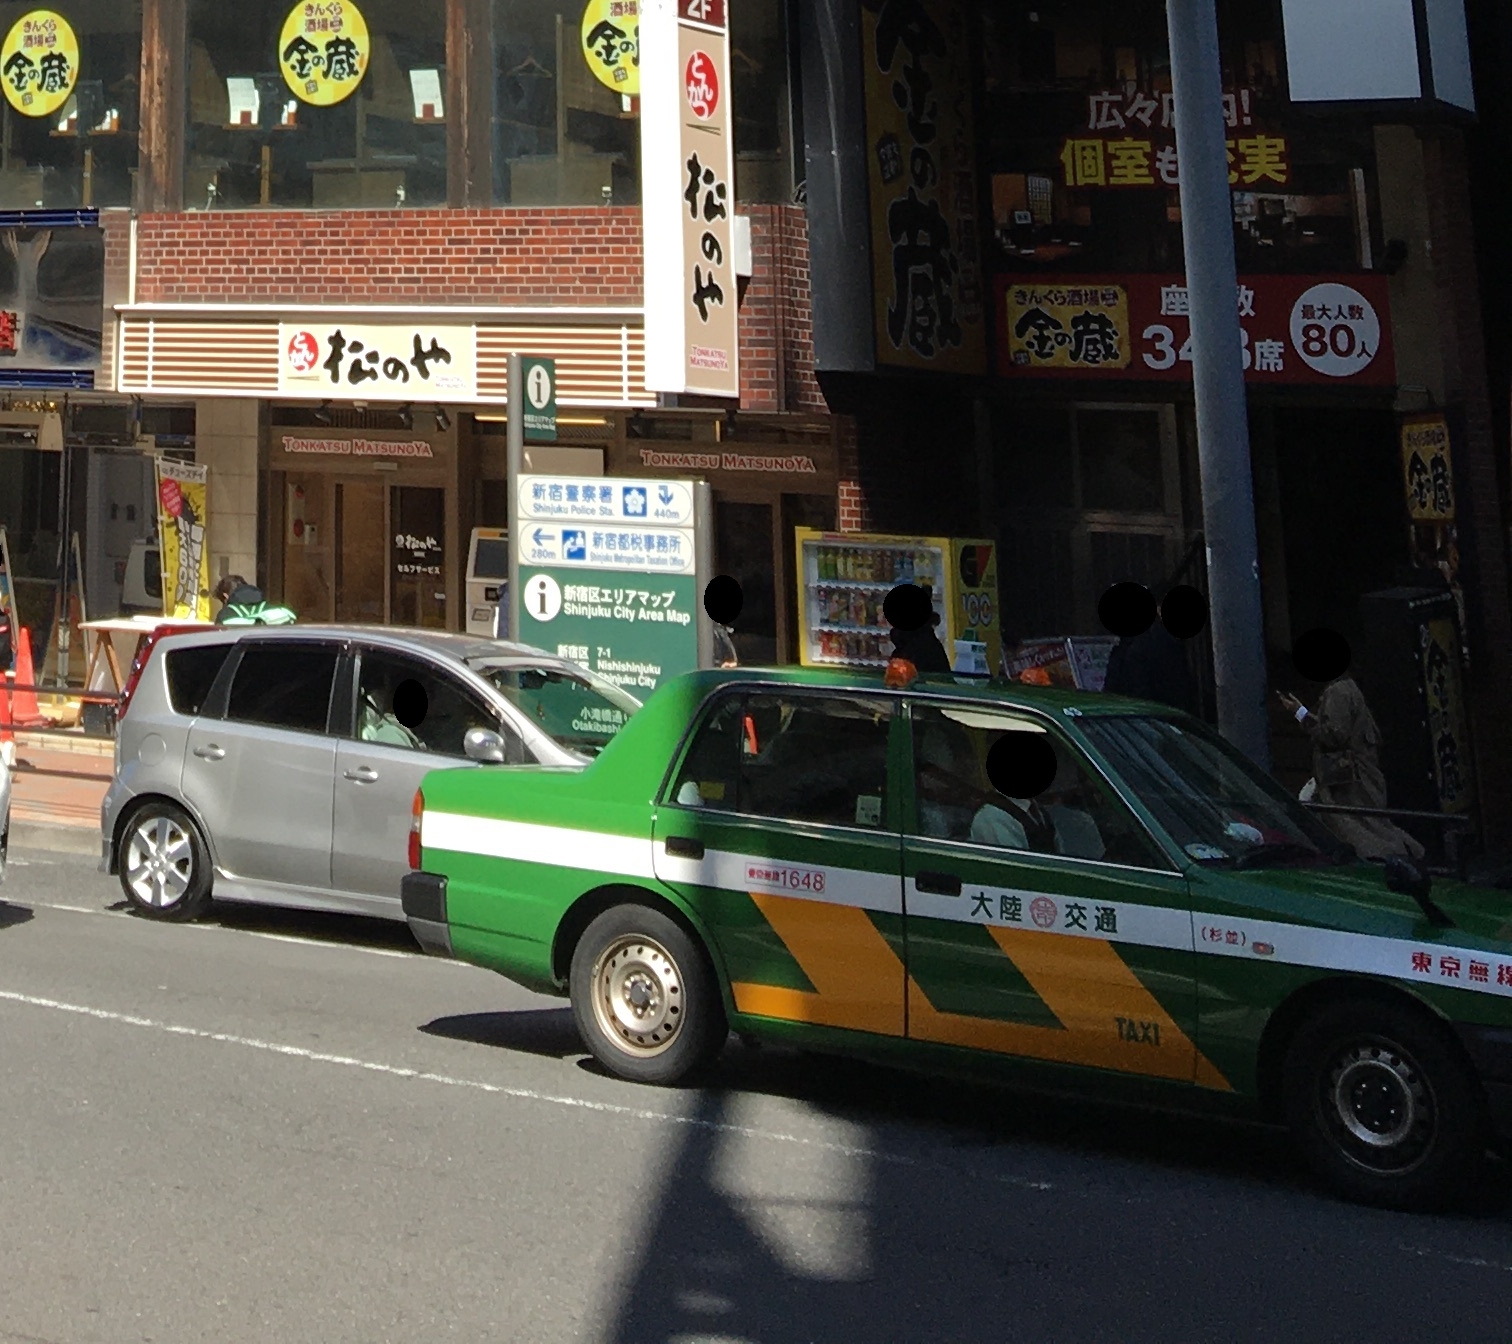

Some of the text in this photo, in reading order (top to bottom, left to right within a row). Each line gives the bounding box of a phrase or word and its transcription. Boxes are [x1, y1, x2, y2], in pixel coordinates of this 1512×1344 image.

[305, 2, 343, 16] きんくら
[23, 18, 57, 32] きんくら
[586, 19, 639, 68] 金の
[283, 33, 360, 82] 金の蔵
[4, 49, 71, 92] 金の蔵
[684, 151, 727, 324] 松のや
[1014, 288, 1100, 306] きんくら酒場
[1301, 303, 1365, 321] 最大人数
[1015, 307, 1121, 364] 金の蔵
[1301, 323, 1372, 360] 80人
[323, 329, 452, 385] 松のや
[690, 345, 727, 359] TONKATSU
[282, 436, 433, 458] TONKATSU MATSUNOYA
[640, 449, 816, 473] TONKATSU MATSUNOYA
[532, 483, 613, 503] 新宿警察署
[533, 503, 568, 516] Shinjuku
[571, 504, 596, 516] Police
[654, 509, 680, 519] 440m
[593, 531, 681, 554] 新宿都税事務所
[532, 549, 556, 559] 280m
[564, 584, 676, 608] 新宿区エリアマップ
[564, 602, 690, 626] Shinjuku City Area Map
[557, 644, 589, 659] 新宿区
[597, 647, 611, 658] 7-1
[597, 659, 661, 676] Nishishinjuku
[637, 675, 656, 690] City
[781, 870, 824, 891] 1648
[970, 890, 1119, 934] 大陸 交通
[1201, 926, 1246, 947] (杉並)
[1412, 952, 1512, 987] 東京無線
[1114, 1015, 1162, 1047] TAXI
